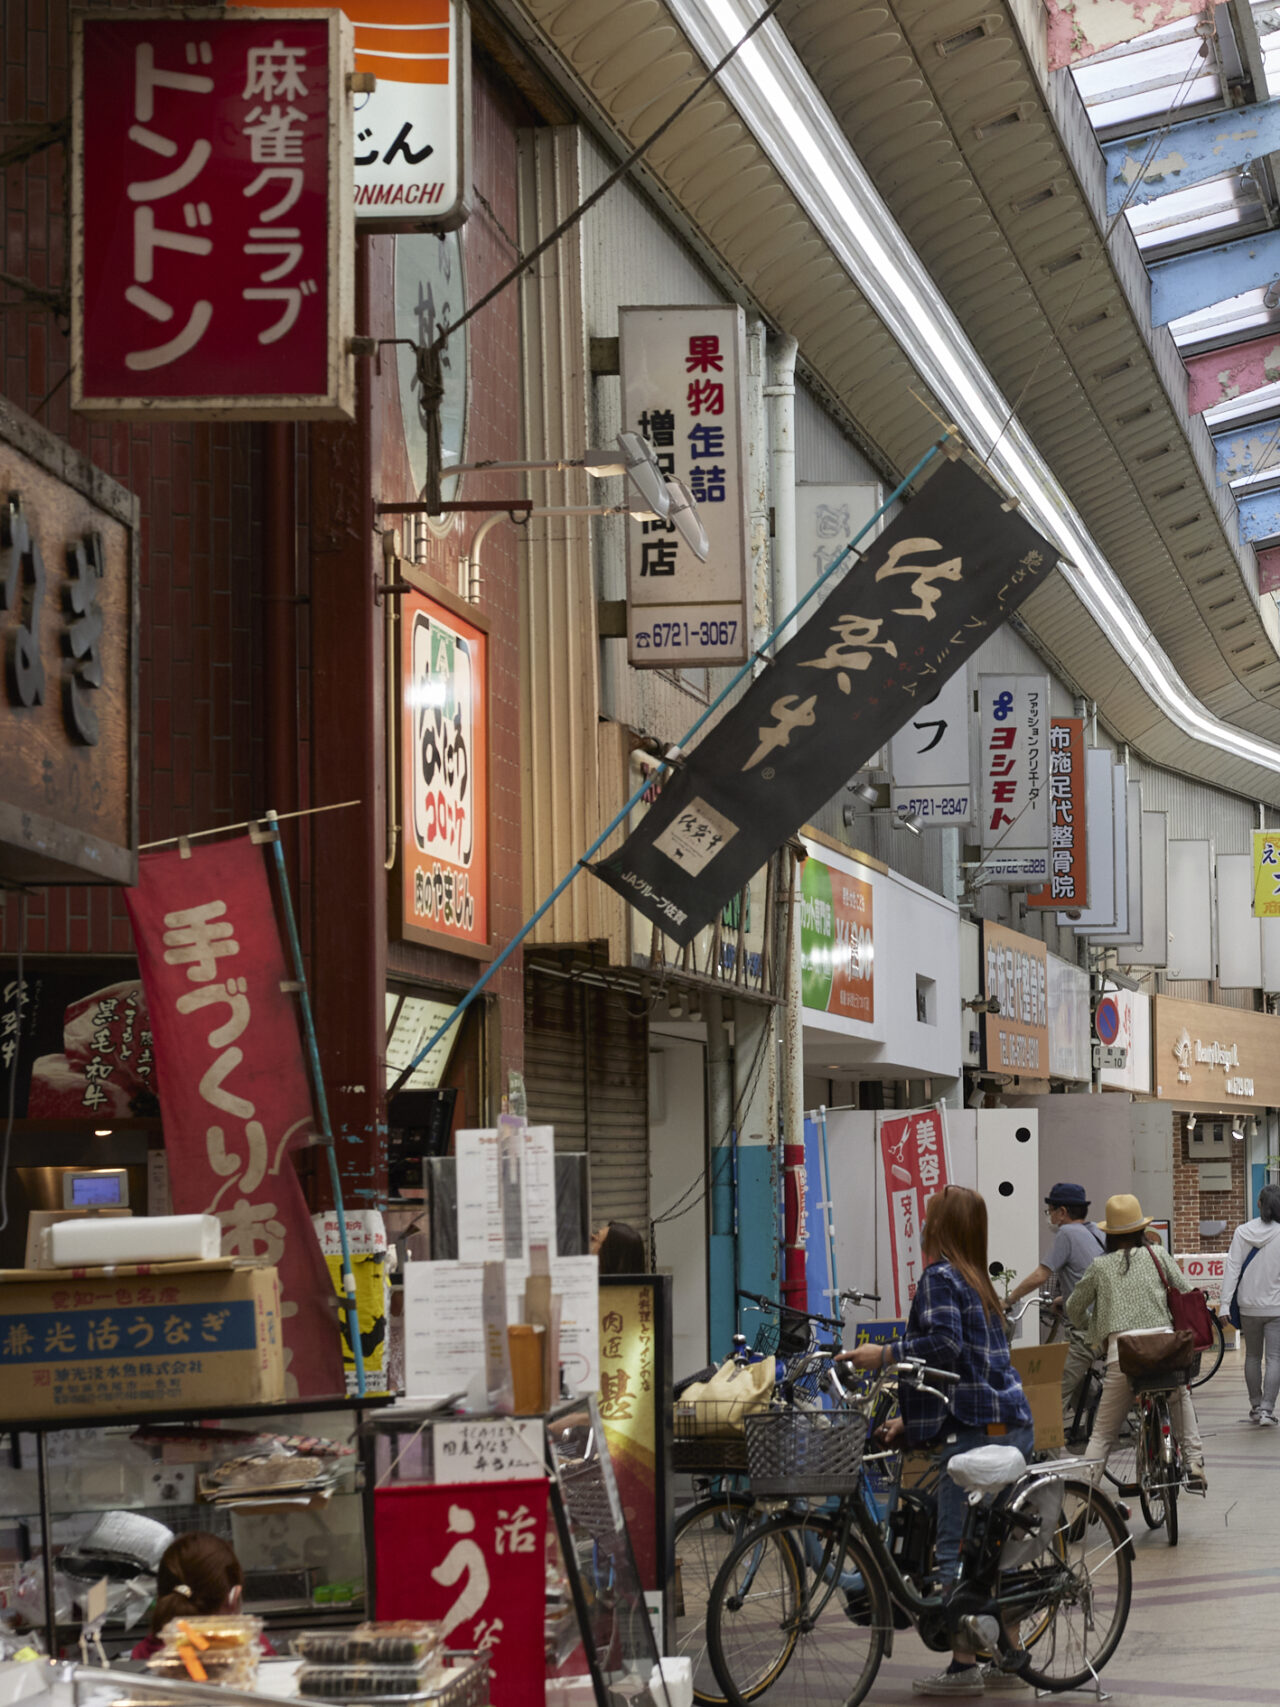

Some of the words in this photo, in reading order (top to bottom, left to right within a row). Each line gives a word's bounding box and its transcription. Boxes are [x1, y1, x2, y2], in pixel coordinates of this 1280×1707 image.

[126, 41, 213, 371] ドンドン
[242, 40, 317, 345] 麻雀クラブ
[653, 621, 737, 648] 6721-3067
[1050, 725, 1075, 899] 布施足代整骨院
[3, 1308, 231, 1356] 兼光活うなぎ
